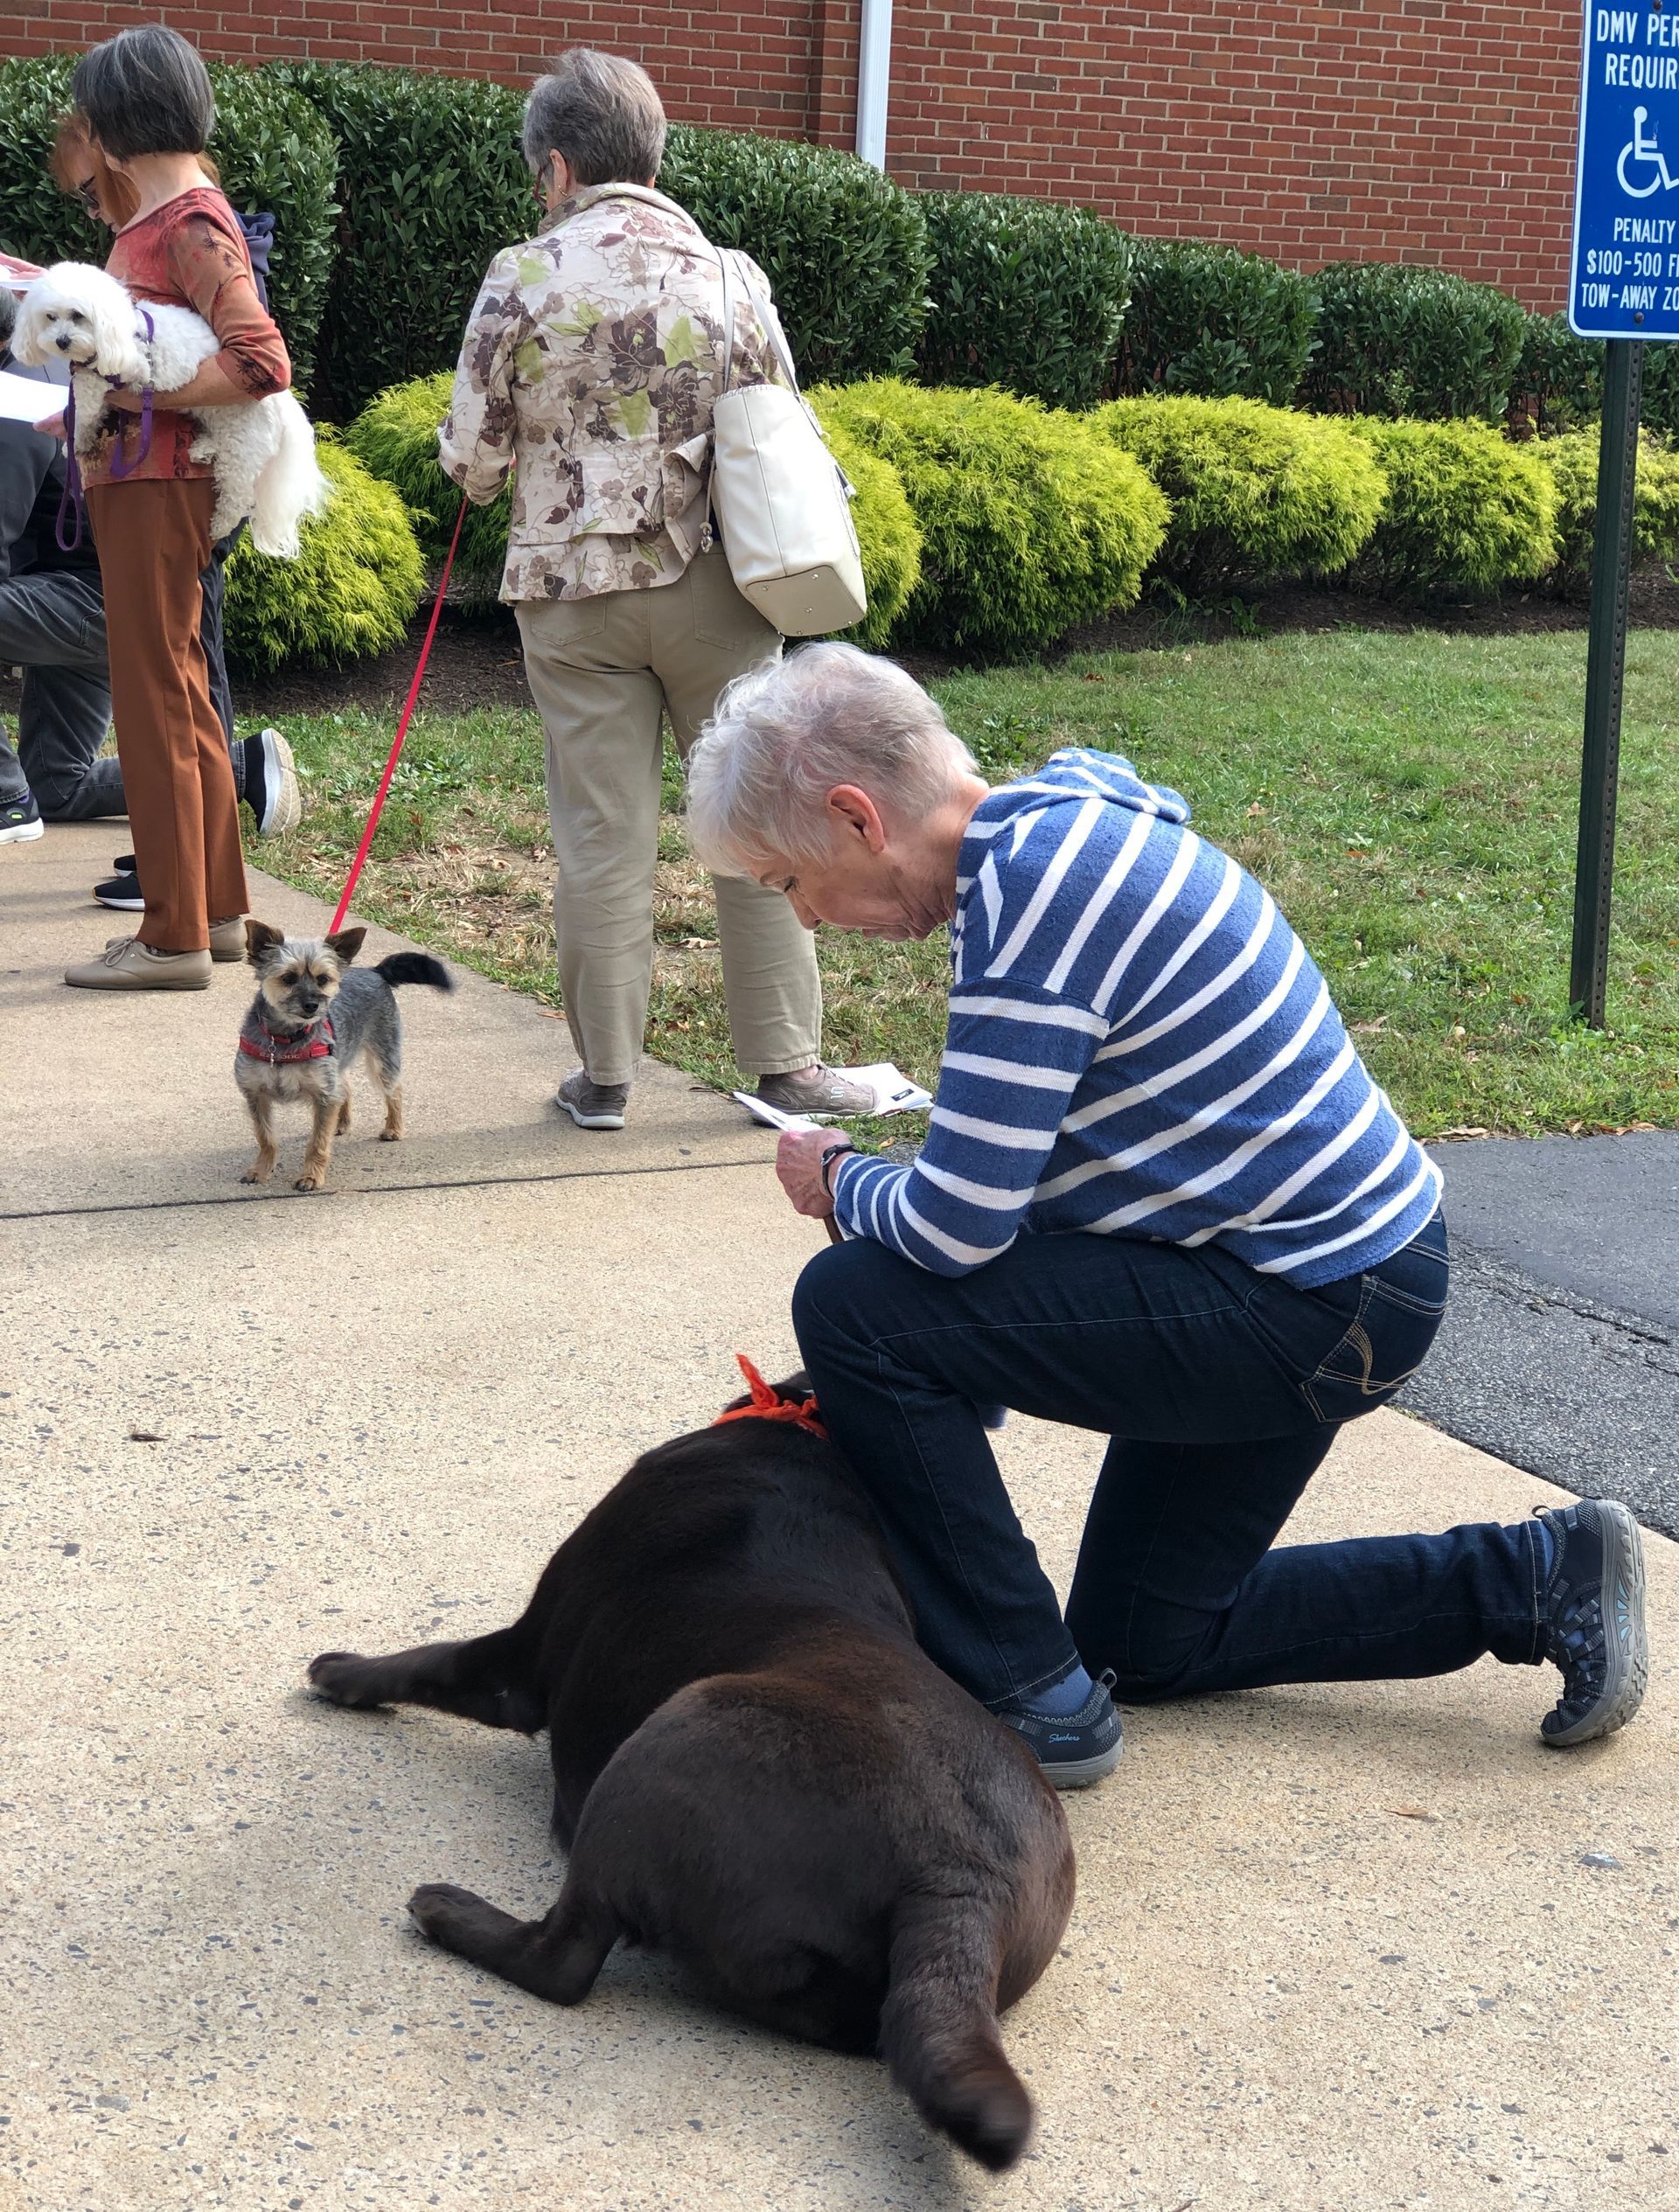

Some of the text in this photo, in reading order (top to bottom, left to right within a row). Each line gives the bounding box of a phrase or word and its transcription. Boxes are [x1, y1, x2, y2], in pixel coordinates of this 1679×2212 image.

[1597, 9, 1639, 44] DMV
[1613, 217, 1676, 244] PENALTY
[1586, 248, 1662, 277] $100-500
[1581, 282, 1658, 310] TOW-AWAY
